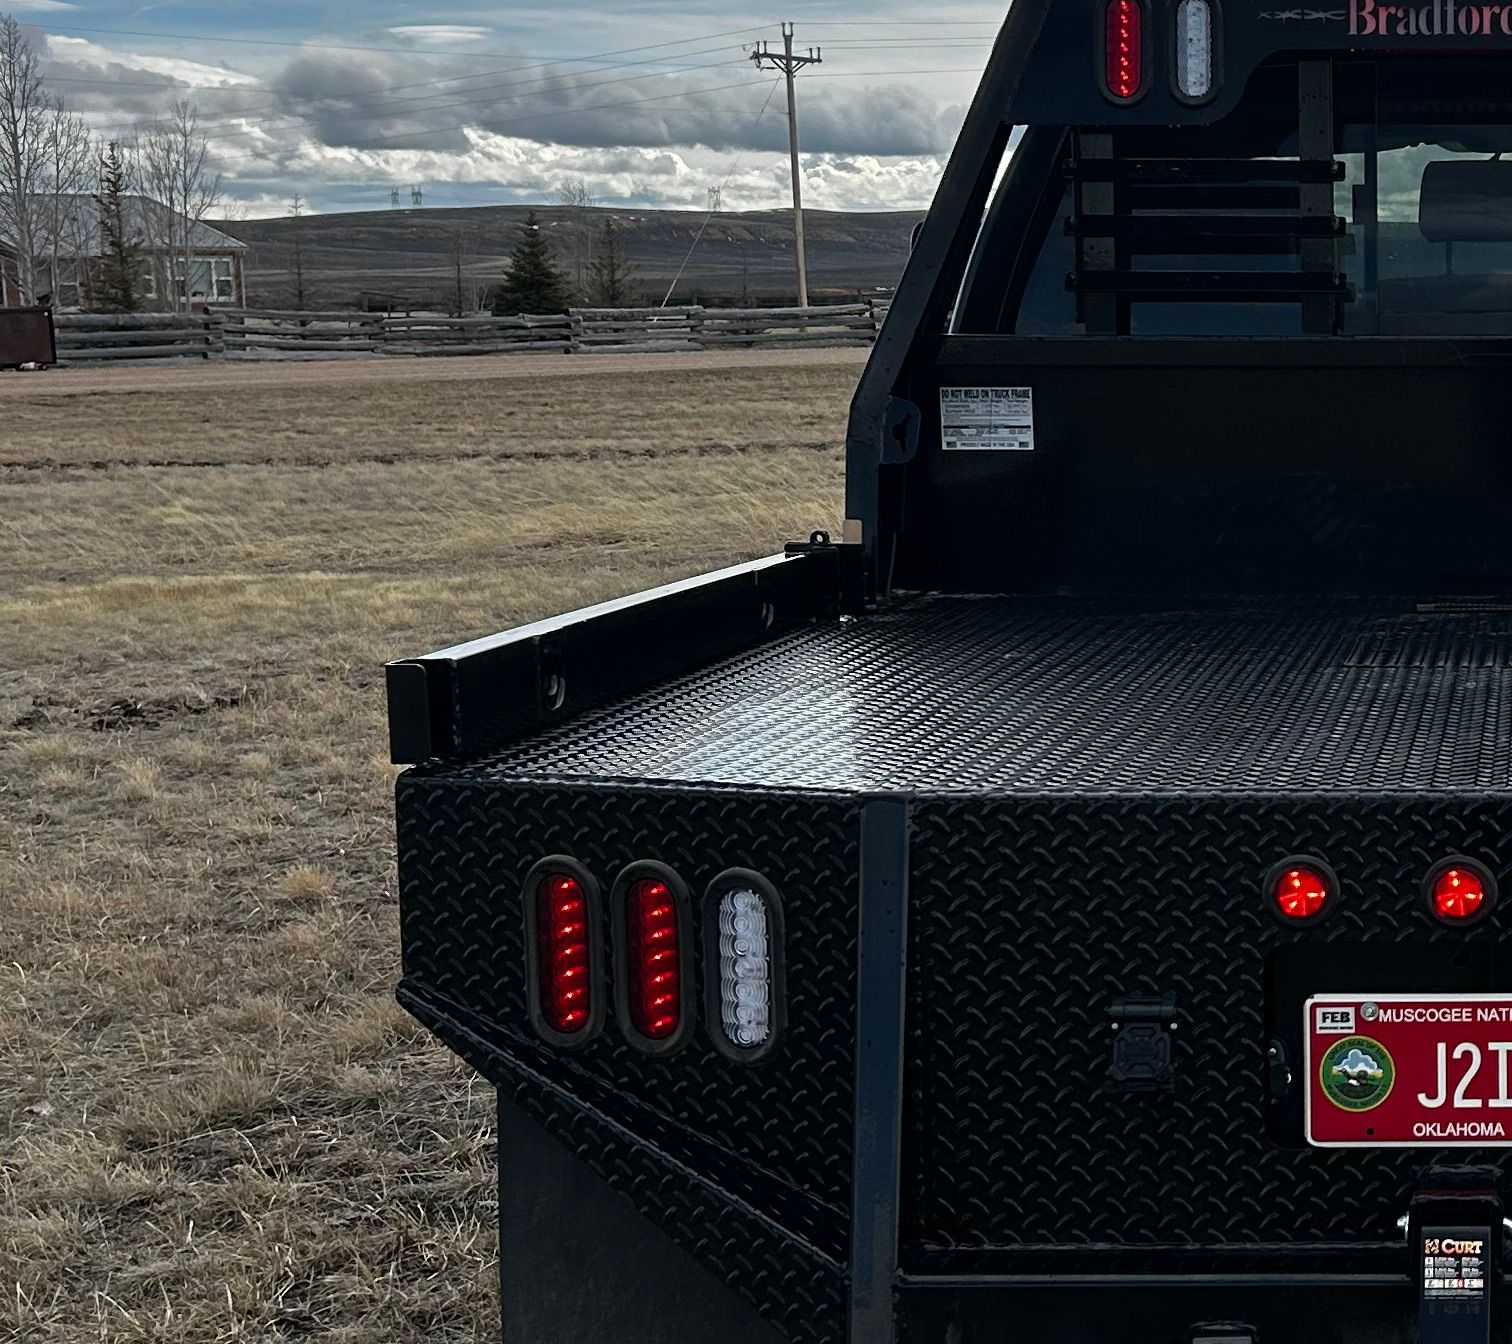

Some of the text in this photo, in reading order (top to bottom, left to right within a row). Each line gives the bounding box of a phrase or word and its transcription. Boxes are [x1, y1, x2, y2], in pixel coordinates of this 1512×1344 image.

[1322, 1011, 1351, 1023] FEB
[1378, 1007, 1473, 1022] MUSCOGEE
[1413, 1122, 1505, 1137] OKLAHOMA
[1441, 1238, 1483, 1254] CURT
